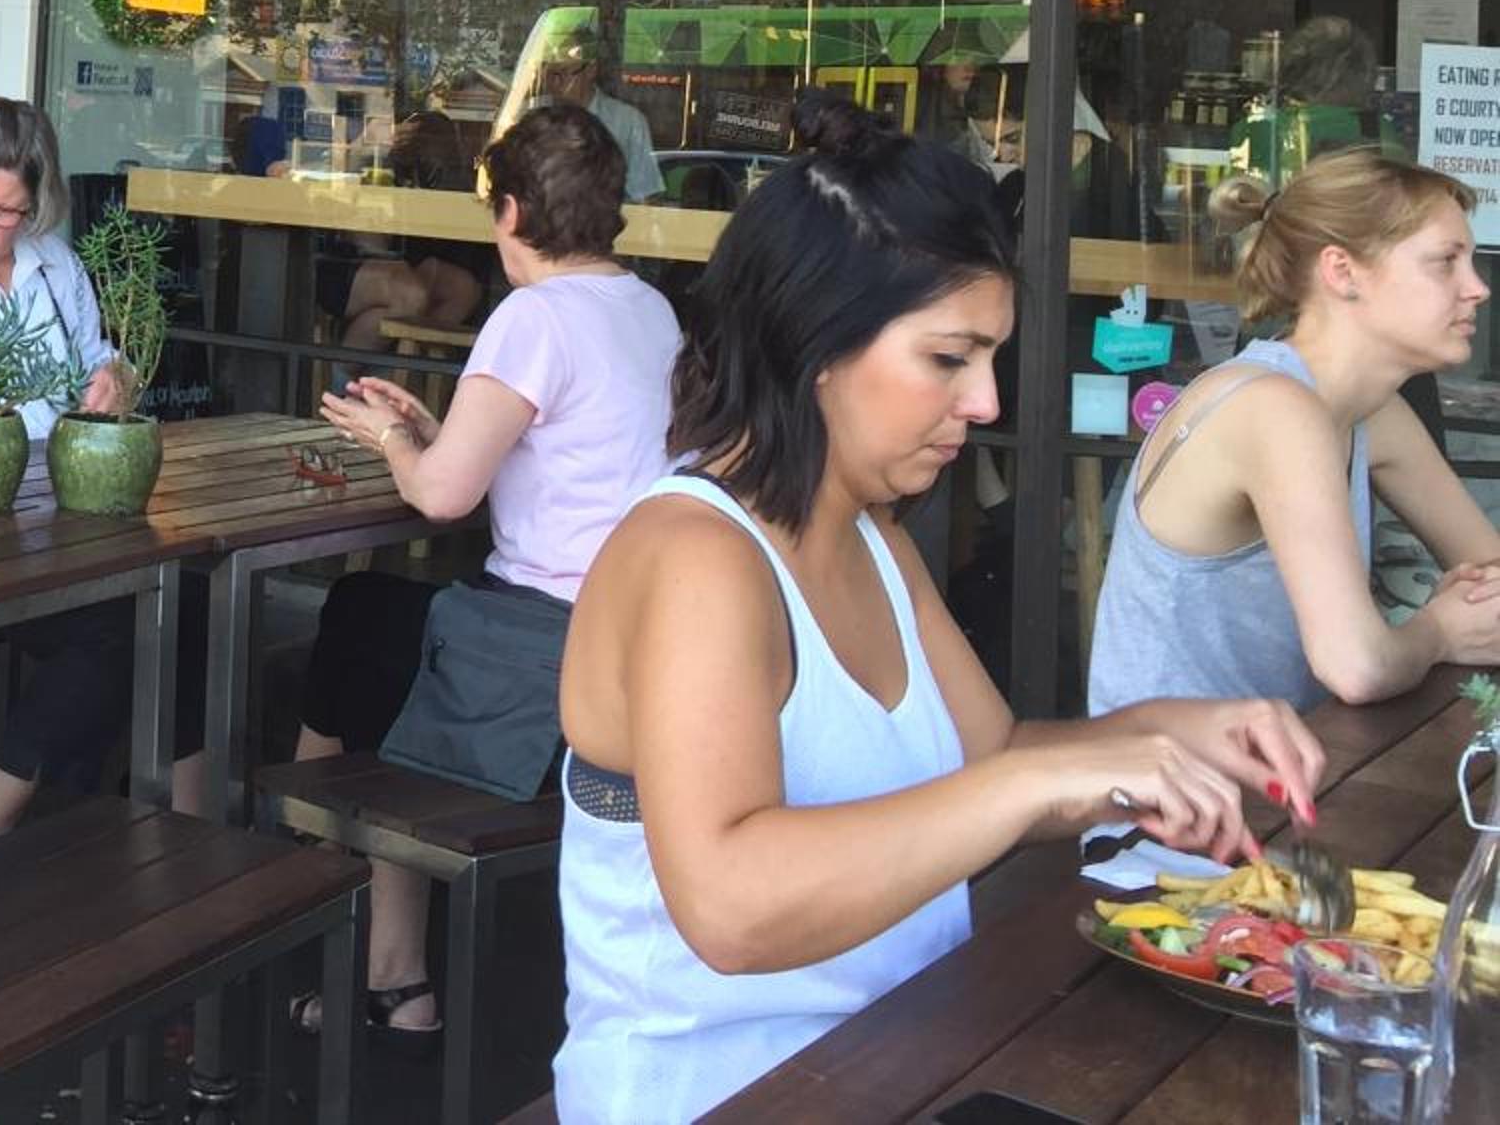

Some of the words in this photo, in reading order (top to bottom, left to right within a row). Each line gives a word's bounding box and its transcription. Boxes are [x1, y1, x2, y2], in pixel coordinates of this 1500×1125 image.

[1438, 65, 1490, 86] EATING
[1436, 97, 1445, 116] &
[1435, 127, 1467, 146] NOW
[1470, 129, 1500, 148] OPE
